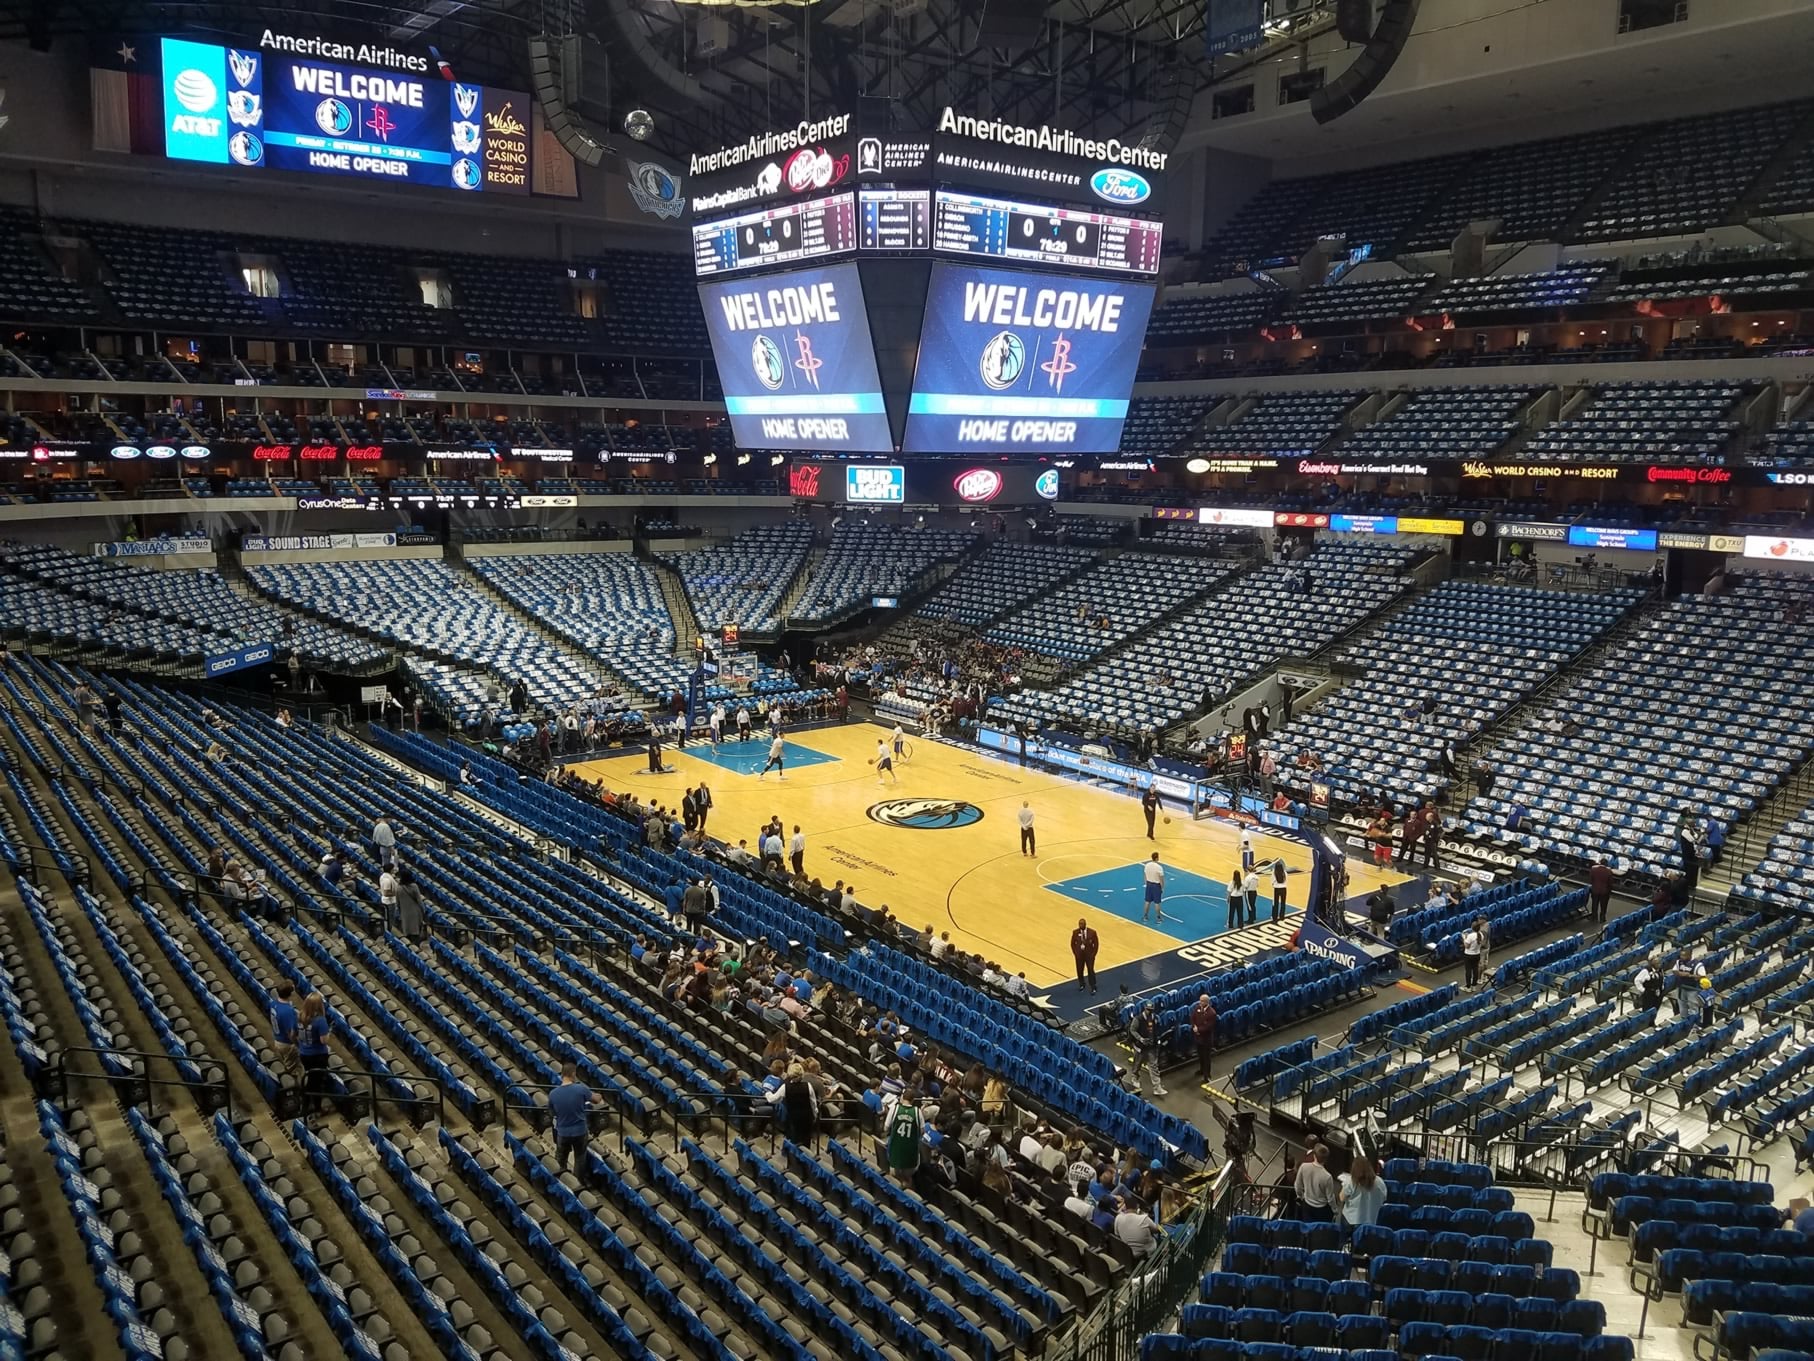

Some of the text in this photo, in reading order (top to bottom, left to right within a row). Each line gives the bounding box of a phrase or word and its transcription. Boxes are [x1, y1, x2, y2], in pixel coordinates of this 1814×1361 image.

[260, 29, 428, 72] American Airlines
[292, 65, 424, 108] WELCOME
[172, 114, 221, 137] AT&T
[485, 104, 527, 137] WinStar
[487, 138, 525, 152] WORLD
[689, 112, 850, 176] AmericanAirlinesCenter
[938, 106, 1168, 171] AmericanAirlinesCenter
[885, 142, 930, 151] AMERICAN
[485, 150, 527, 165] CASINO
[884, 151, 926, 160] AIRLINES
[309, 152, 409, 177] HOME OPENER
[499, 163, 514, 172] AND
[487, 171, 526, 185] RESORT
[1101, 173, 1138, 199] Ford
[782, 219, 792, 239] 0
[1023, 218, 1035, 237] 0
[1076, 225, 1087, 244] 0
[745, 227, 755, 246] 0
[720, 282, 840, 331] WELCOME
[963, 281, 1124, 332] WELCOME
[762, 417, 849, 441] HOME OPENER
[958, 419, 1076, 442] HOME OPENER
[253, 446, 291, 460] Coca-Cola
[301, 447, 338, 460] Coca-Cola
[346, 447, 383, 460] Coca-Cola
[427, 450, 492, 460] American Airlines
[1100, 461, 1148, 471] American Airlines
[1298, 460, 1339, 475] Eisenberg
[1341, 463, 1428, 475] America's Gourmet Beef Hot Dog
[1494, 466, 1525, 475] WORLD
[1527, 466, 1562, 477] CASINO
[1581, 468, 1618, 479] RESORT
[856, 469, 894, 485] BUD
[1648, 466, 1732, 483] Community Coffee
[1776, 473, 1807, 484] LSO
[849, 483, 901, 499] LIGHT
[299, 498, 341, 510] CyrusOne
[1511, 525, 1565, 537] BACHENDORF'S
[1659, 534, 1706, 542] EXPERIENCE
[269, 536, 300, 549] SOUND
[302, 536, 330, 548] STAGE
[724, 631, 737, 642] 24
[211, 649, 269, 671] GEICO GEICO
[1230, 744, 1244, 759] 24
[1314, 793, 1326, 802] 24
[830, 856, 862, 869] Center
[1464, 867, 1492, 880] GEICO
[1303, 938, 1357, 970] SPALDING
[896, 1121, 912, 1138] 41
[1071, 1163, 1090, 1174] EPIC
